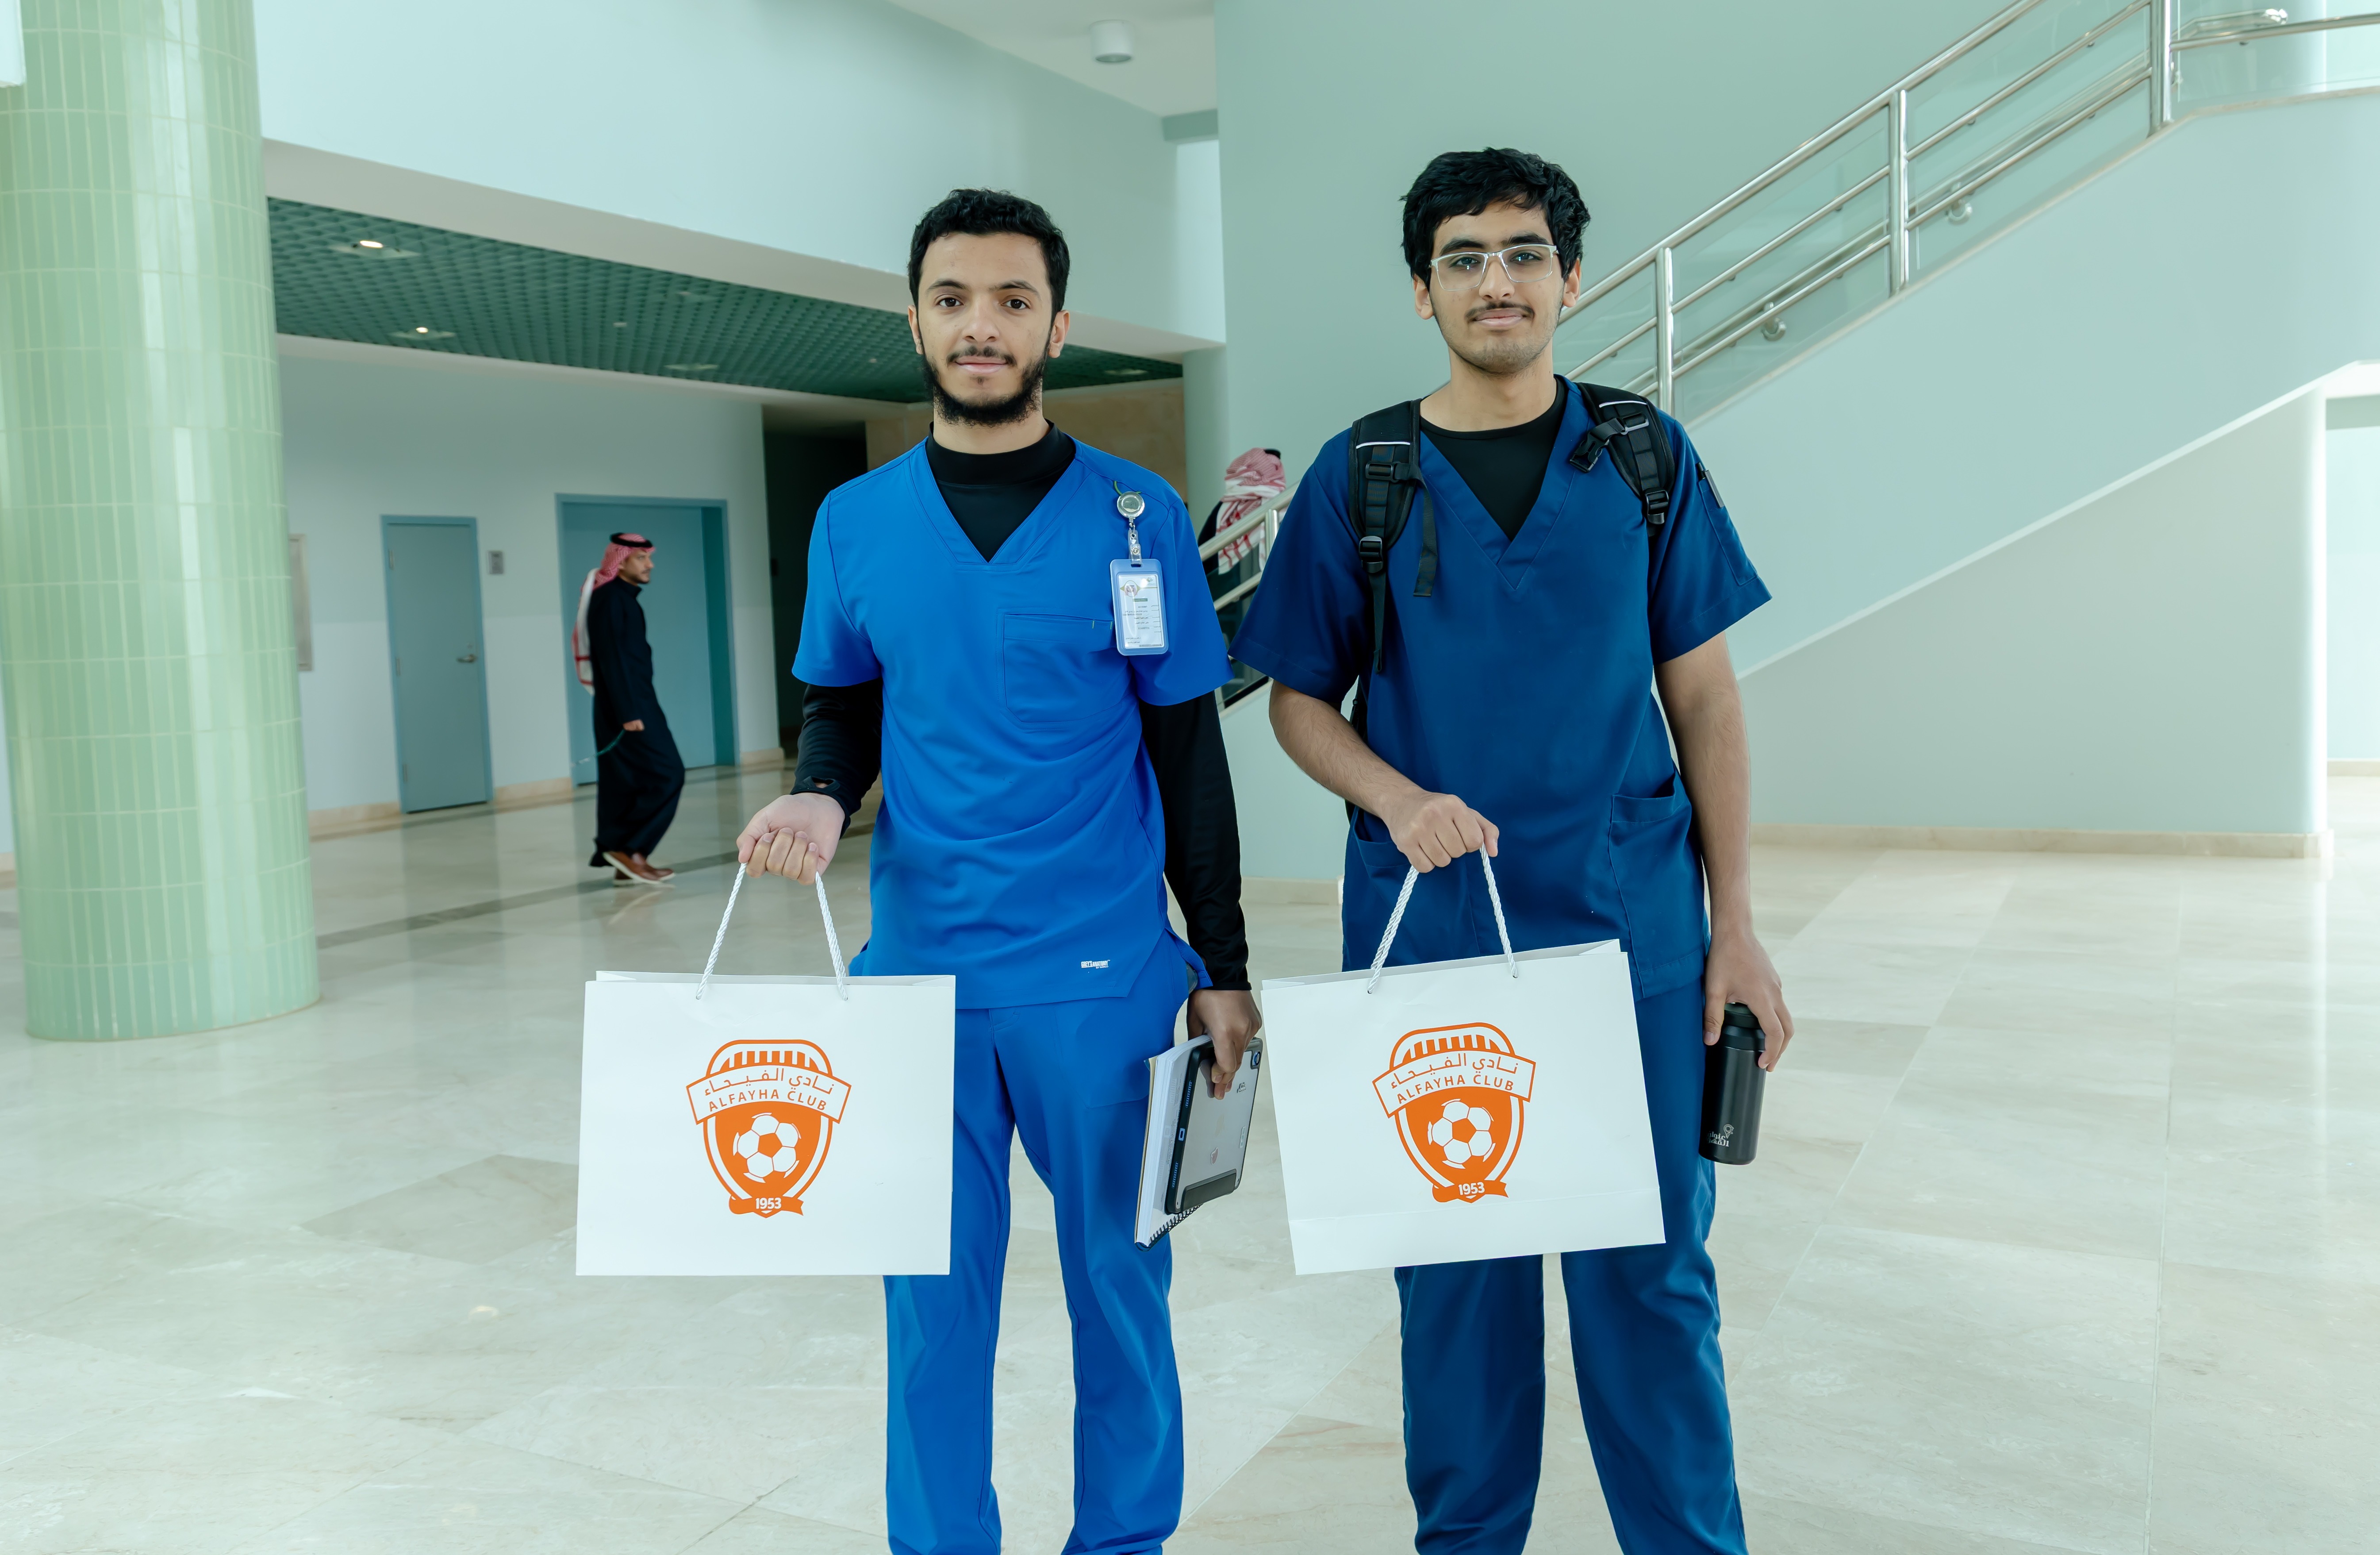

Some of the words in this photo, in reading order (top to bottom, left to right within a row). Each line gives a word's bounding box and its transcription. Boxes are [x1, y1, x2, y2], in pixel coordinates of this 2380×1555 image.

[1390, 1053, 1466, 1089] الفيحاء
[1472, 1056, 1518, 1074] نادي
[704, 1068, 784, 1096] الفيحاء
[788, 1075, 834, 1094] نادي
[1397, 1074, 1466, 1104] ALFAYHA
[1473, 1074, 1513, 1091] CLUB
[709, 1089, 779, 1112] ALFAYHA
[787, 1091, 827, 1111] CLUB
[1707, 1138, 1729, 1147] القهو
[1458, 1182, 1485, 1195] 1953
[755, 1197, 781, 1209] 1953
